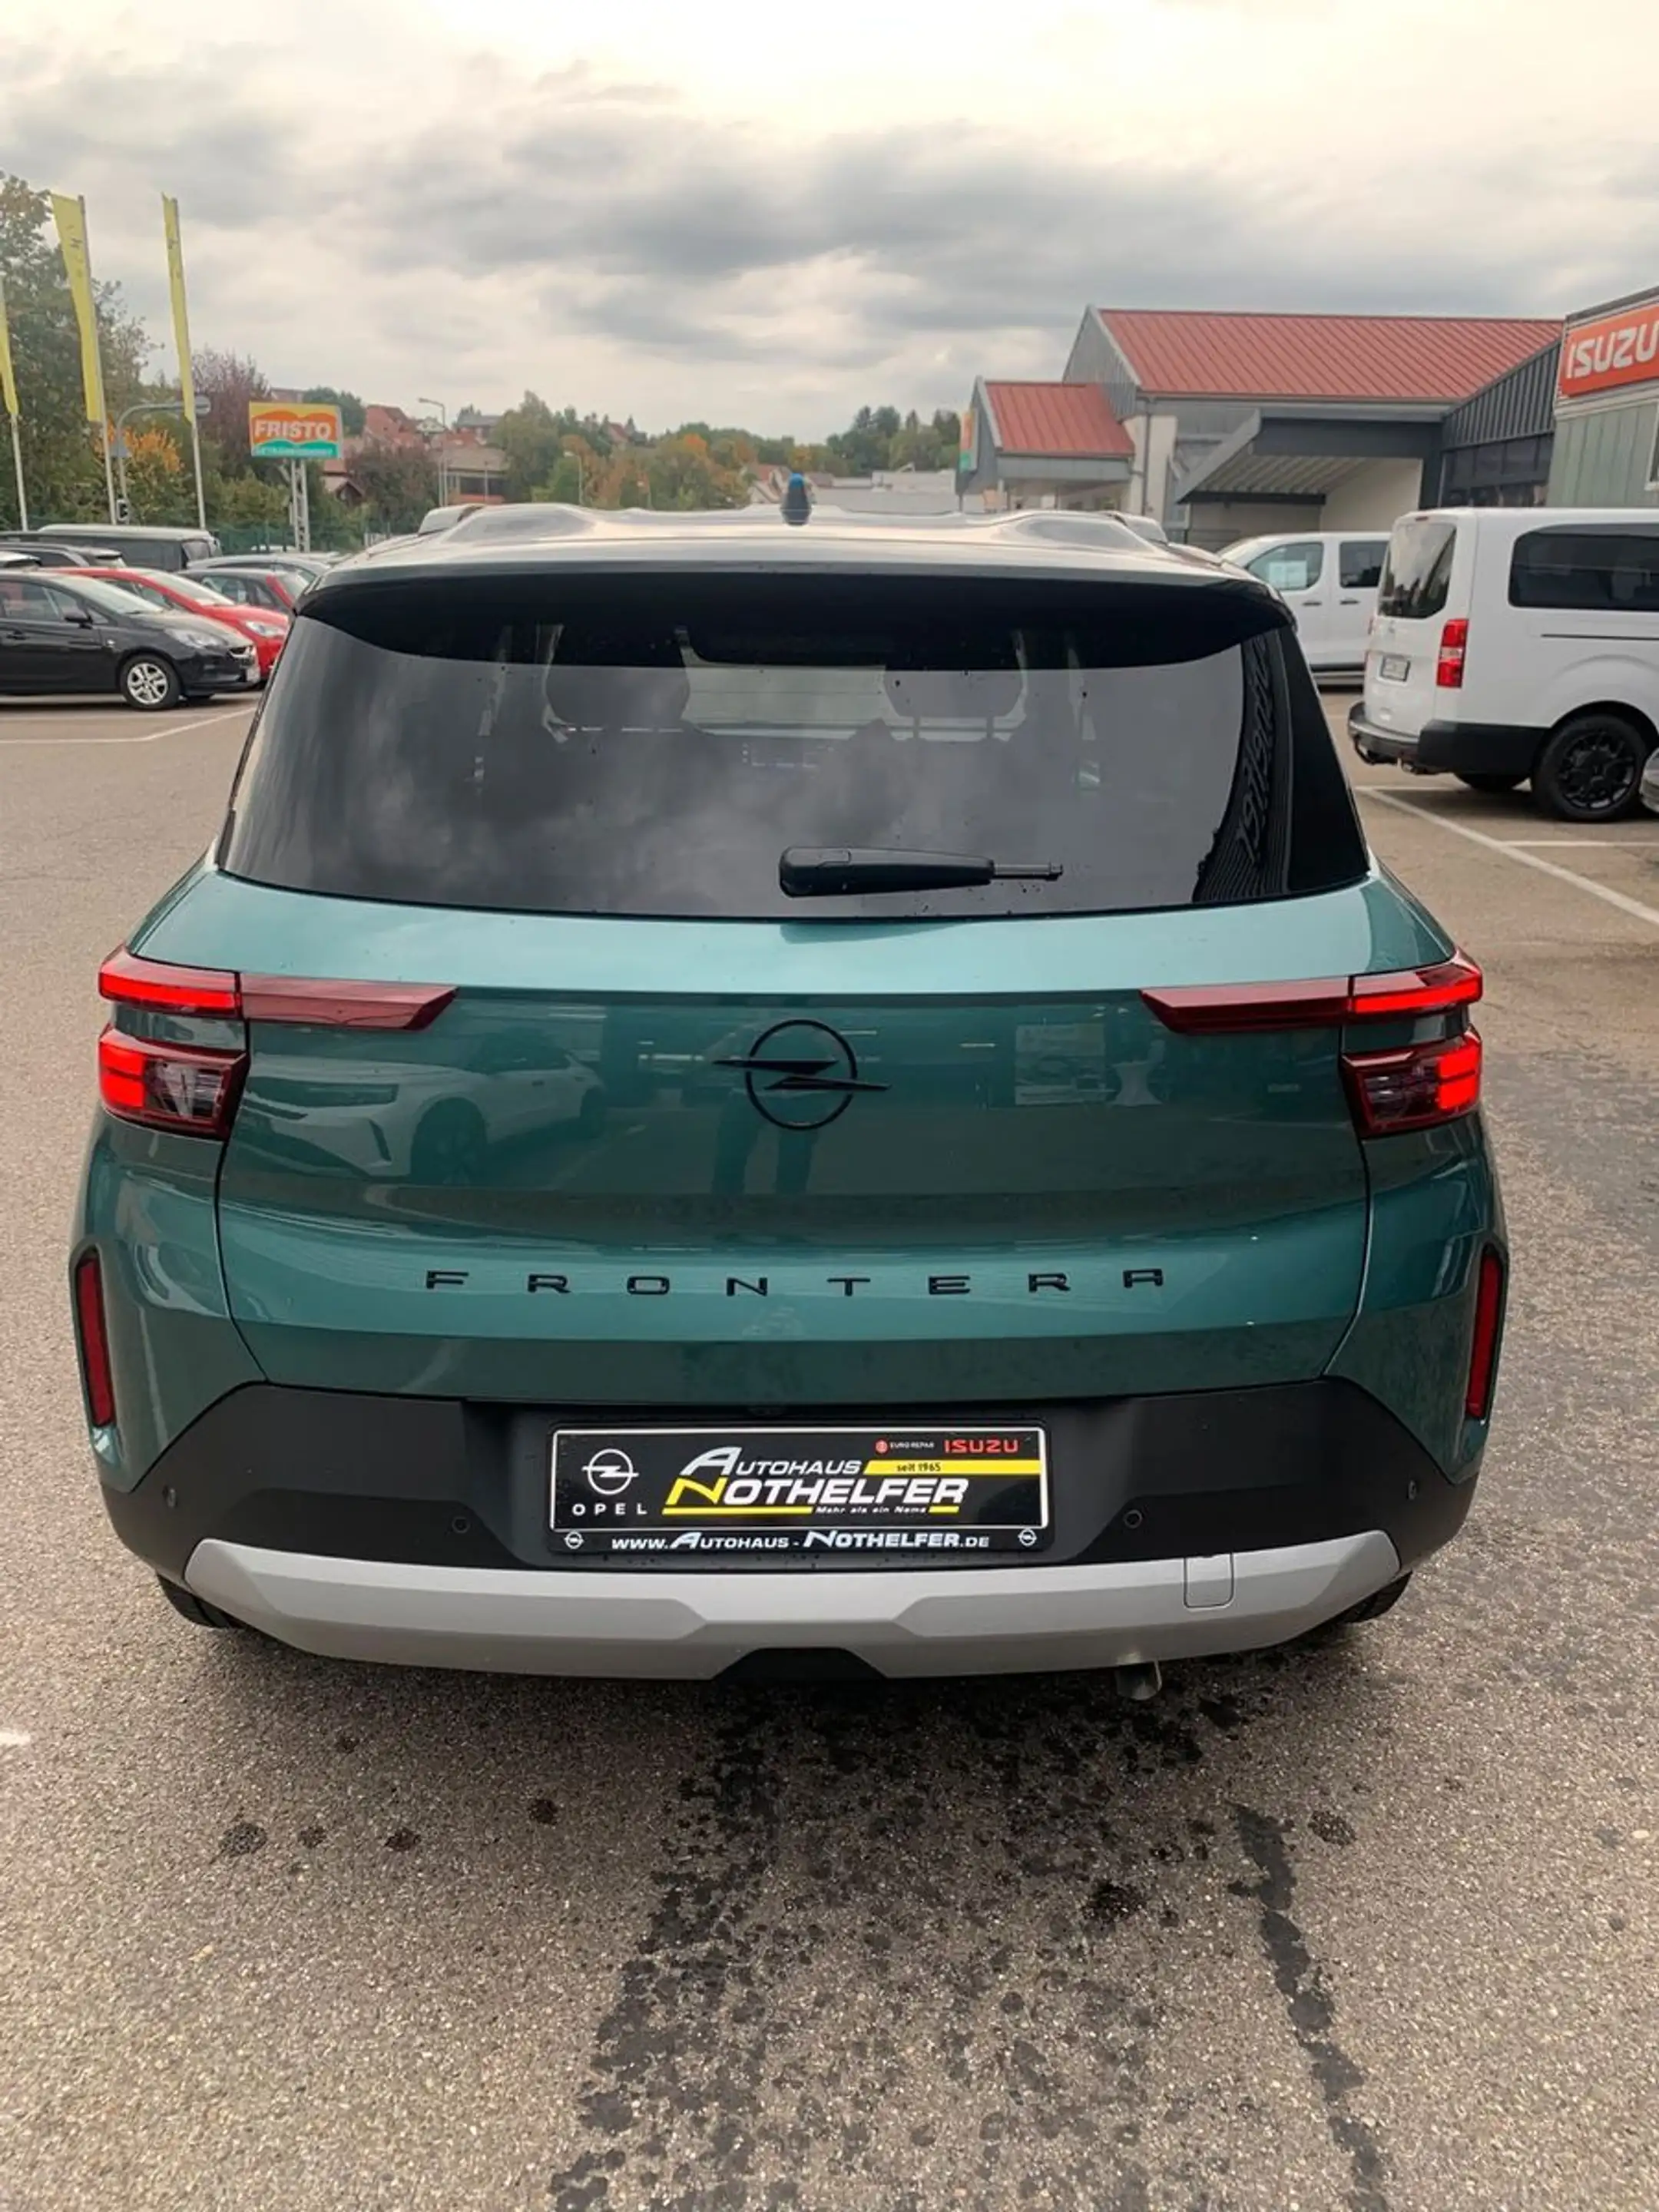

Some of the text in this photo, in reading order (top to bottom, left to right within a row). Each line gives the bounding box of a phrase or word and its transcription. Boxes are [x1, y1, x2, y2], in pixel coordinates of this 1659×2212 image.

[1565, 320, 1659, 379] ISUZU
[254, 419, 331, 440] FRISTO
[426, 1269, 1164, 1297] FRONTERA
[944, 1439, 1019, 1454] ISUZU
[679, 1446, 863, 1476] AUTOHAUS
[896, 1462, 942, 1472] seit 1965
[665, 1477, 969, 1506] NOTHELFER
[571, 1502, 647, 1516] OPEL
